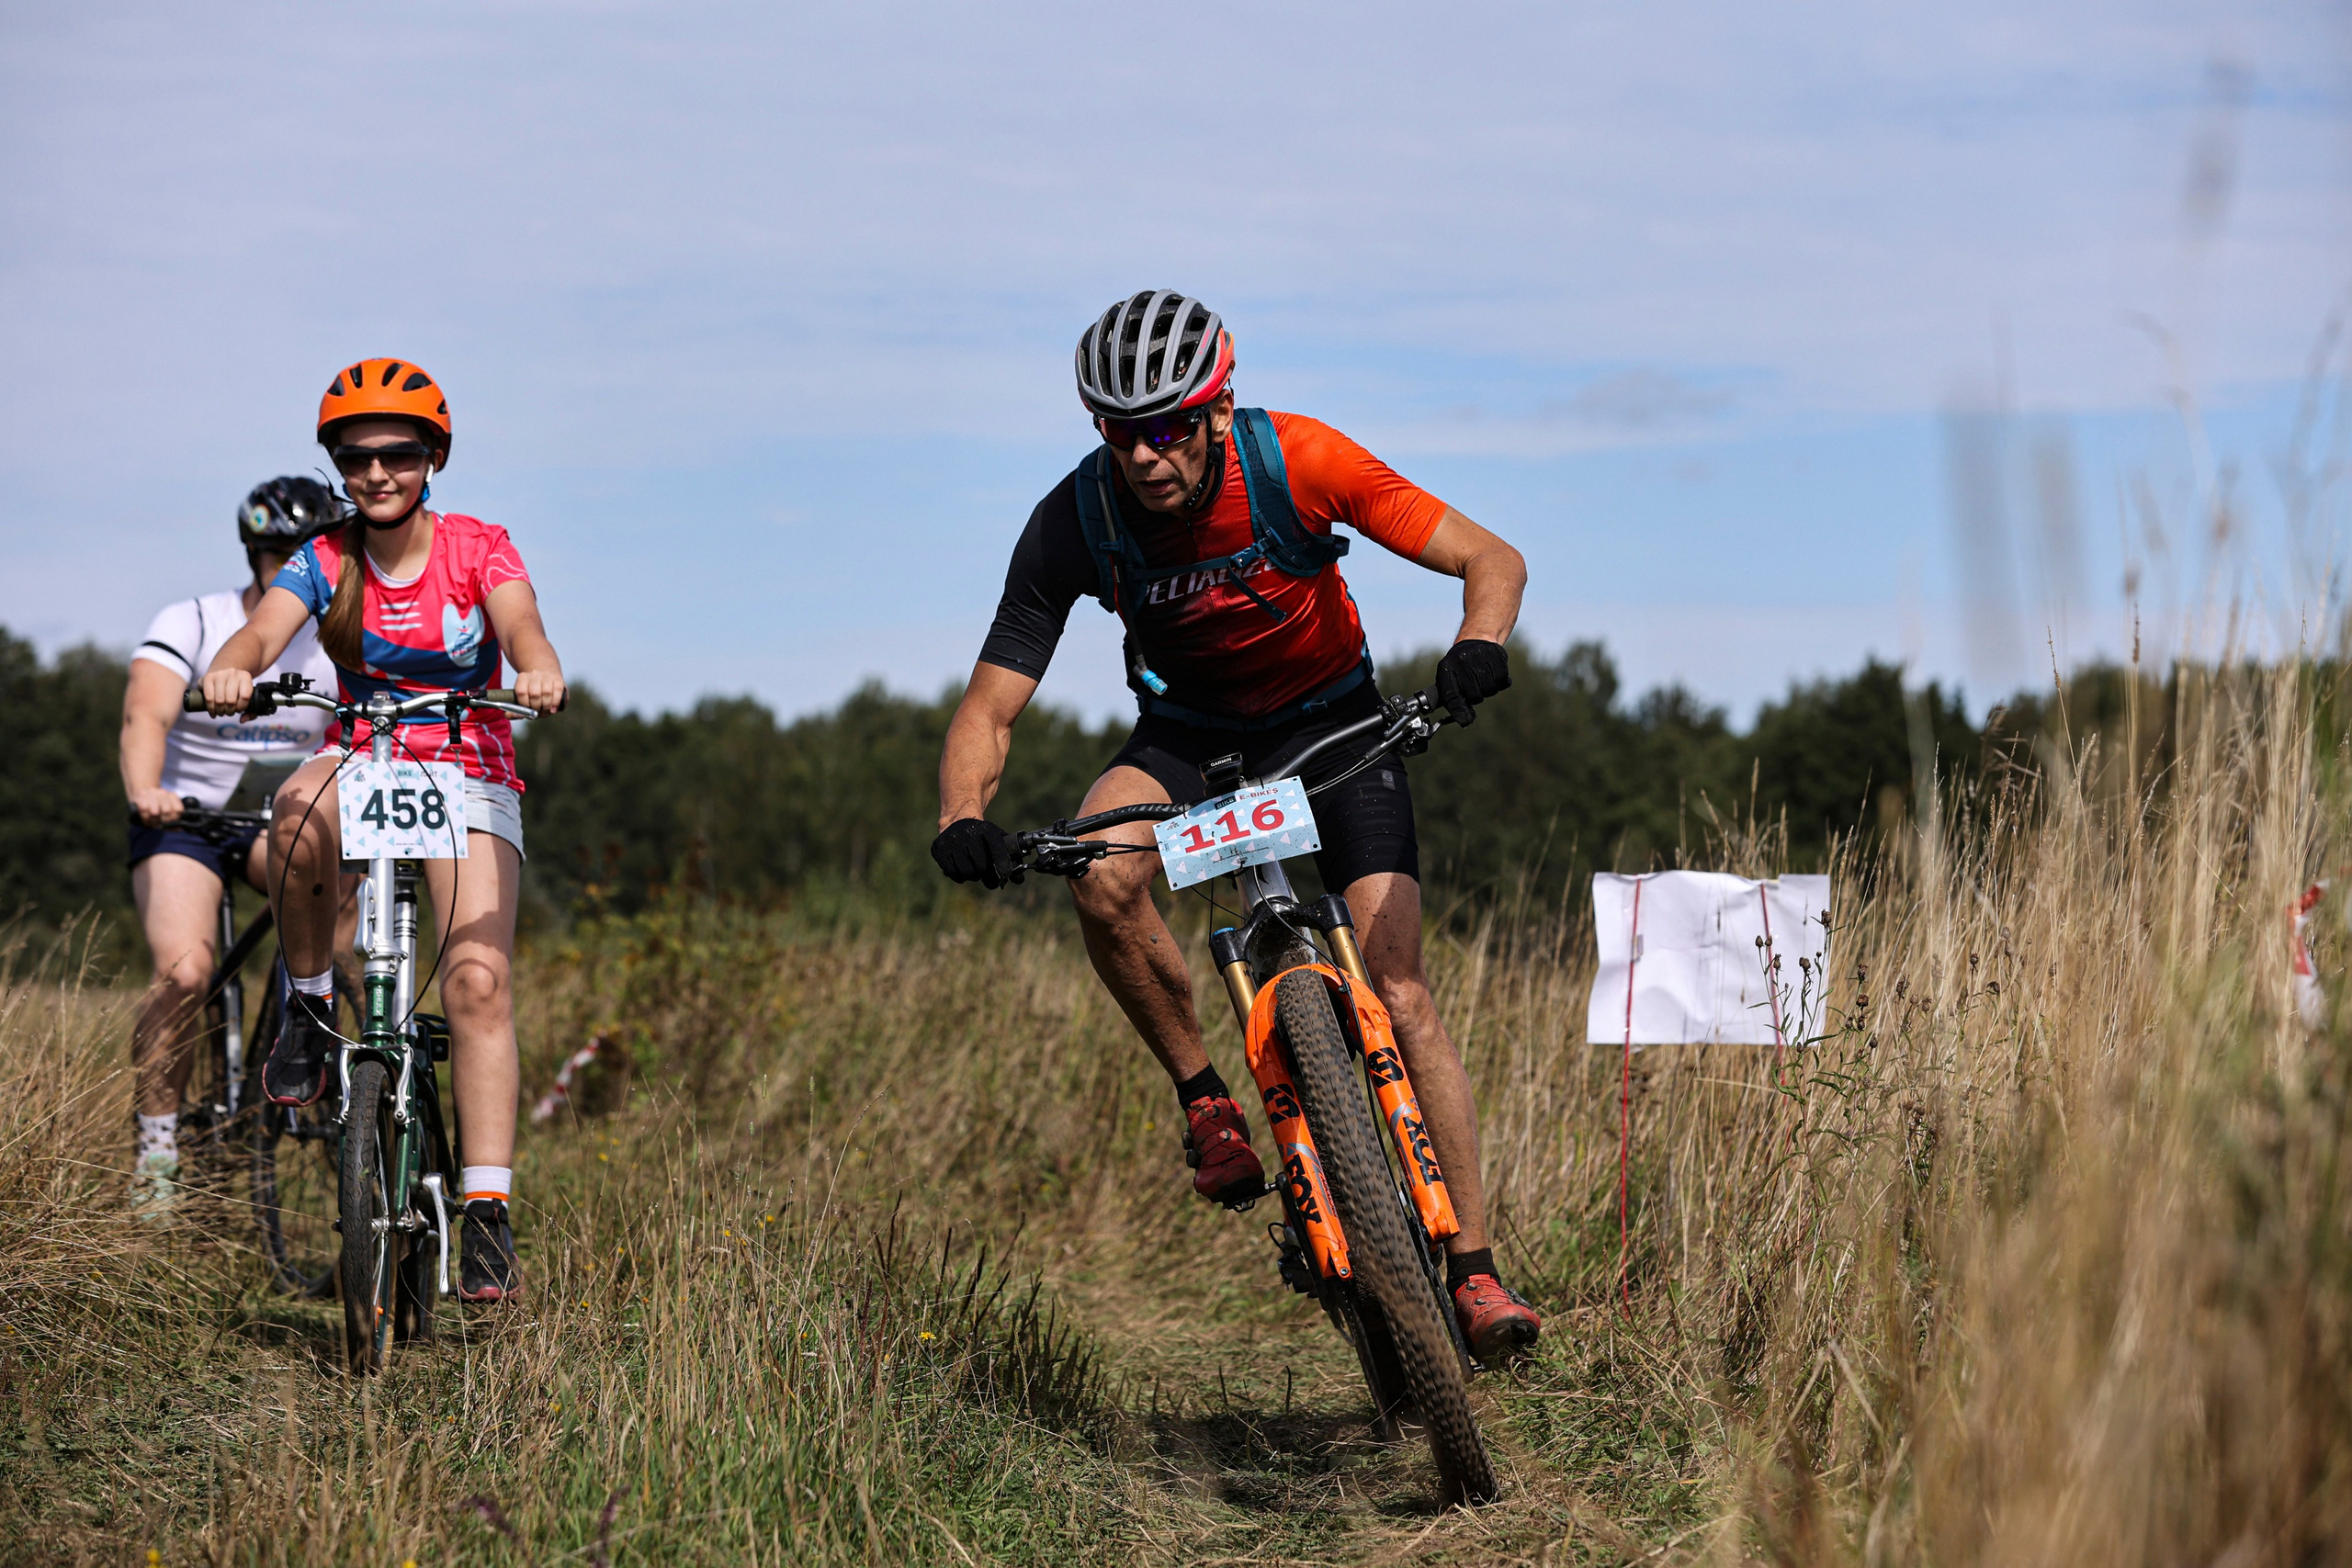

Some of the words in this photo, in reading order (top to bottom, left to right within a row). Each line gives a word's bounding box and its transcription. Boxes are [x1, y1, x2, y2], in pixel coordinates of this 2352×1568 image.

[1210, 757, 1232, 767] GARMIN
[361, 789, 447, 829] 458
[1216, 795, 1235, 809] BIKE
[1239, 787, 1279, 800] E-BIKES
[1180, 798, 1284, 853] 116
[1402, 1116, 1445, 1186] FOX
[1285, 1154, 1322, 1224] FOX
